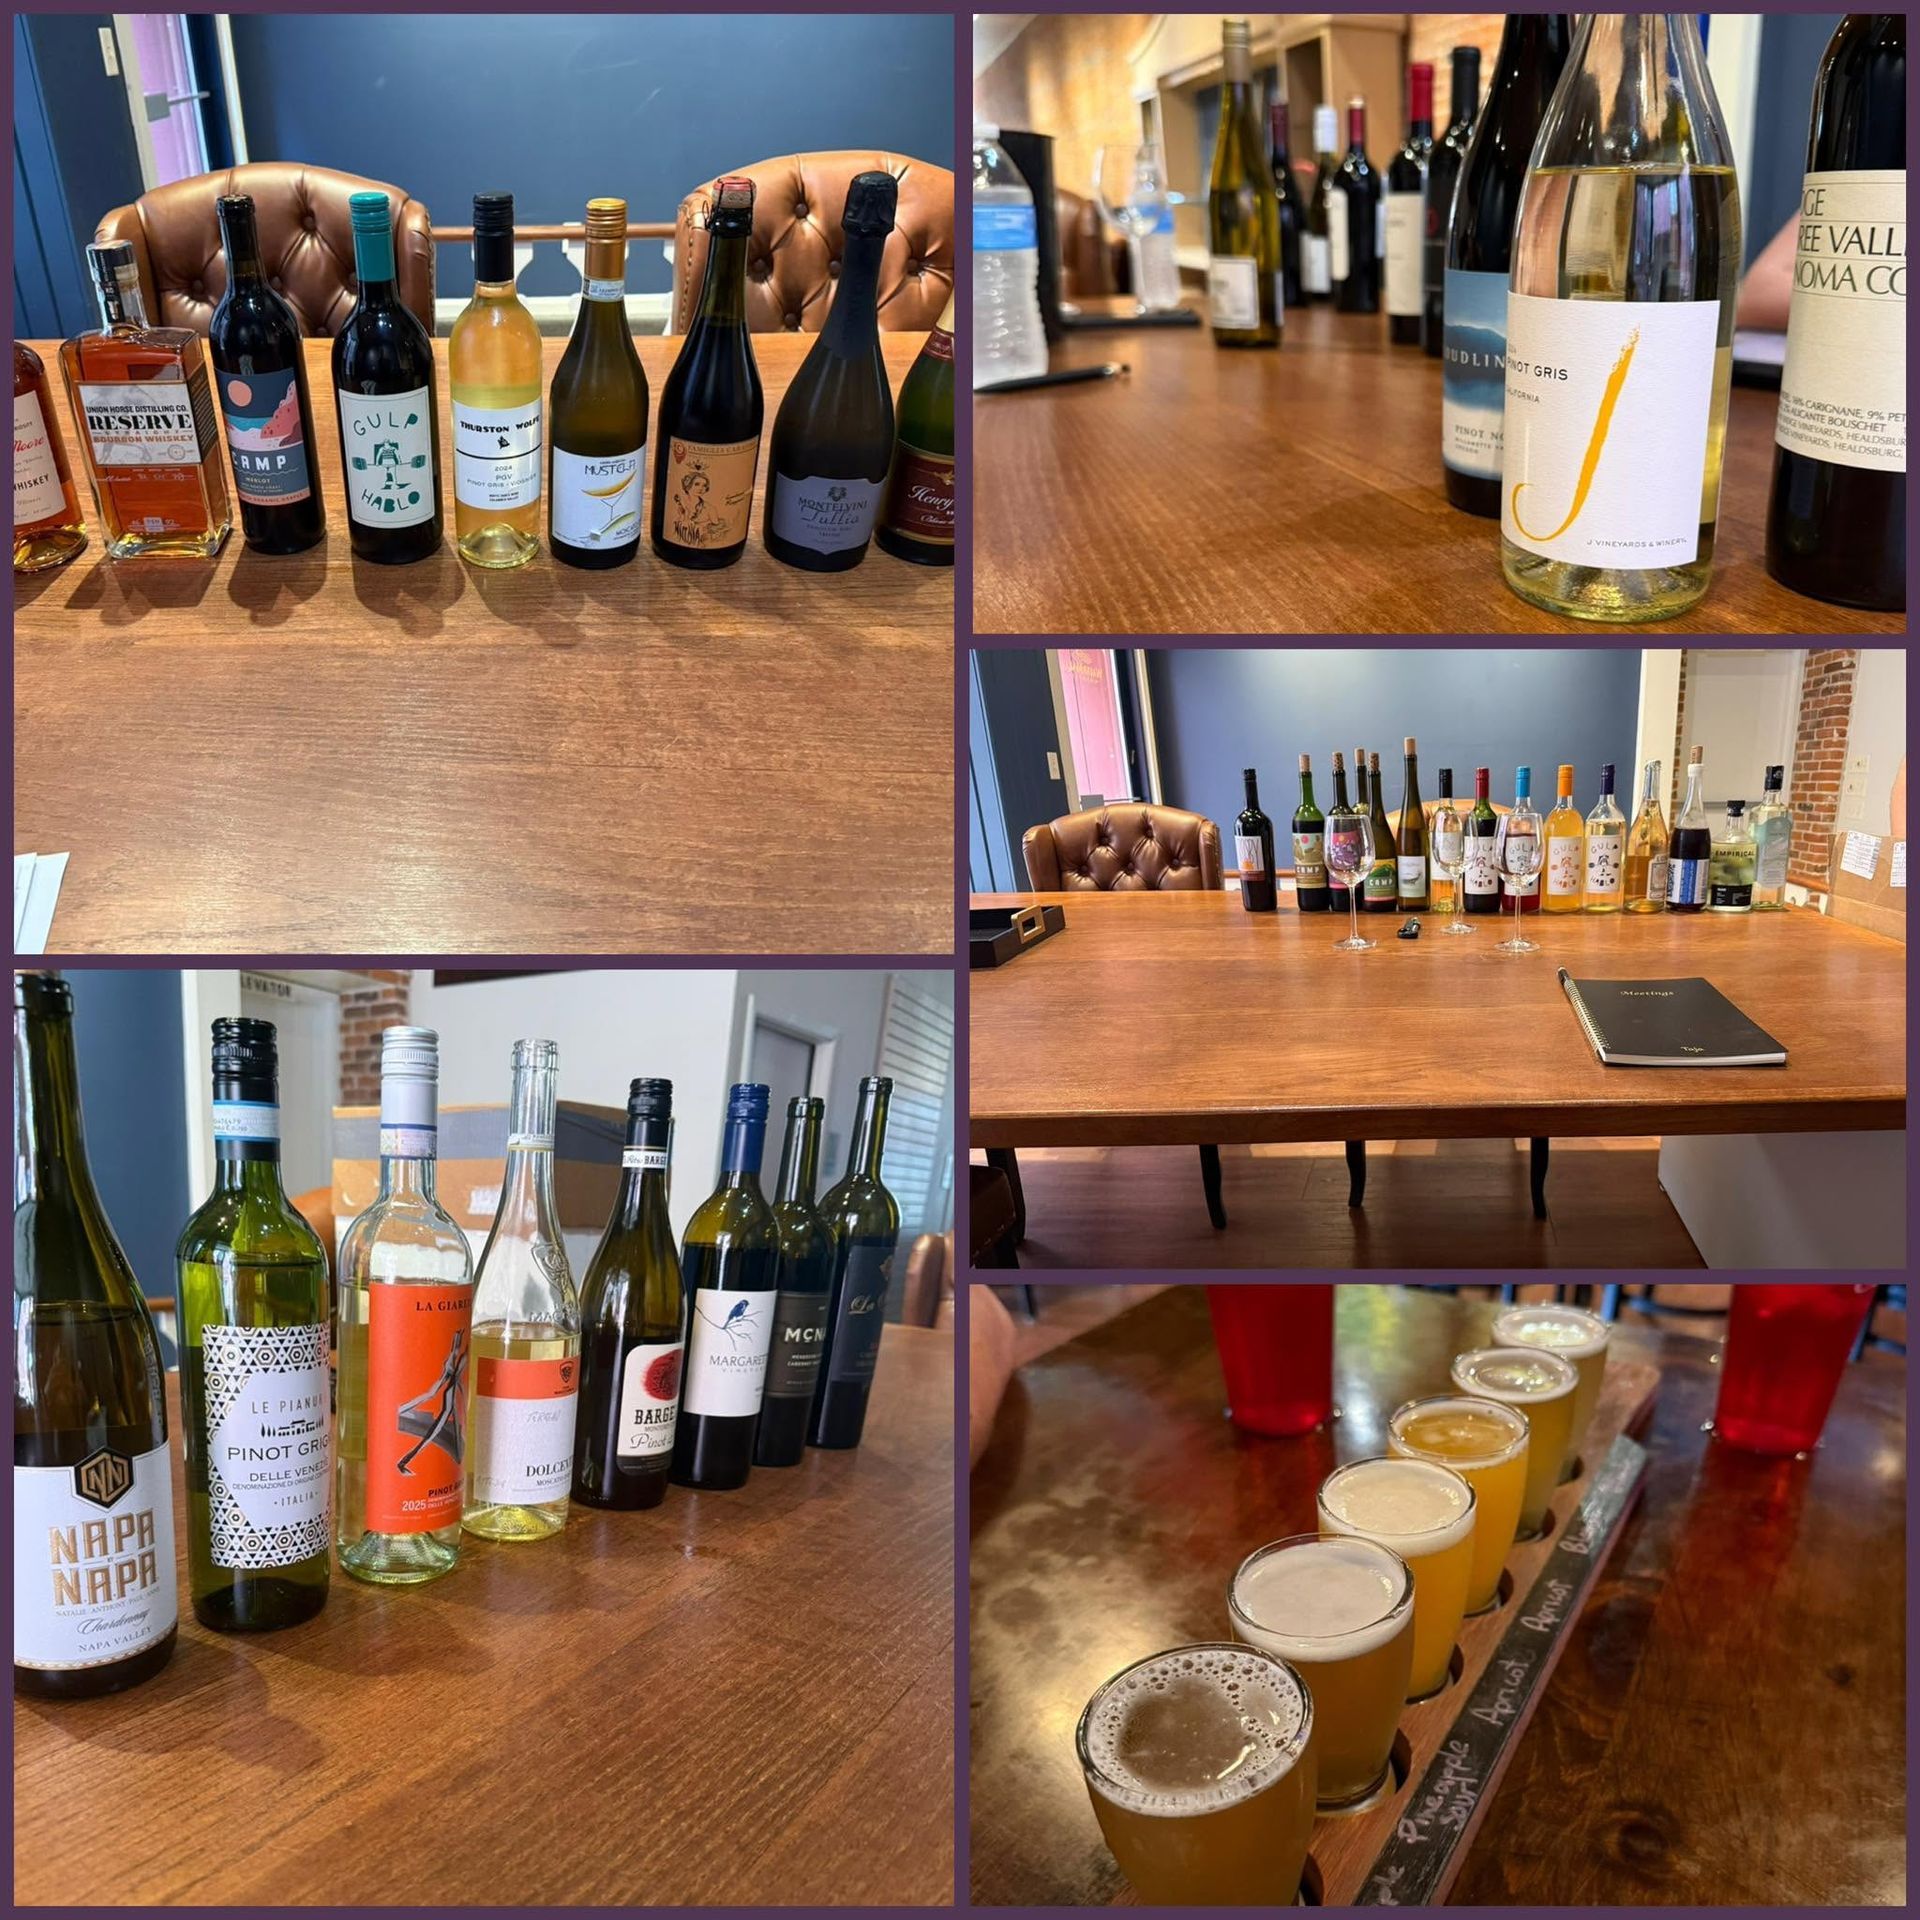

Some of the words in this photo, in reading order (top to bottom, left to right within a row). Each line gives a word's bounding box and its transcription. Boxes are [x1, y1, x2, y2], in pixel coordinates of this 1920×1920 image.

[1534, 365, 1568, 381] GRIS
[87, 406, 109, 414] UNION
[135, 405, 175, 413] DISTILLING
[1867, 411, 1885, 421] 9%
[88, 414, 192, 430] RESERVE
[353, 411, 419, 436] GULP
[460, 420, 510, 433] THURSTON
[1827, 417, 1887, 433] BOUSCHET
[1455, 425, 1486, 439] PINOT
[467, 479, 485, 488] PINOT
[361, 489, 420, 513] HABLO
[799, 497, 868, 511] MONTELVINI
[908, 485, 954, 511] Henry
[1596, 539, 1647, 548] VINEYARDS
[1369, 878, 1393, 886] CAMP
[416, 1301, 434, 1312] LA
[252, 1402, 269, 1414] LE
[630, 1432, 667, 1449] Pinot
[228, 1446, 294, 1461] PINOT
[250, 1470, 292, 1483] DELLE
[233, 1481, 287, 1490] DENOMINAZIONE
[428, 1484, 454, 1497] PINOT
[402, 1499, 427, 1512] 2025
[49, 1507, 156, 1565] NAPA
[56, 1608, 87, 1617] NATALIE
[1520, 1579, 1573, 1633] Apricot
[77, 1607, 151, 1635] Chardonnay
[79, 1642, 111, 1652] NAPA
[114, 1625, 152, 1645] VALLEY
[1470, 1658, 1532, 1727] Apricot
